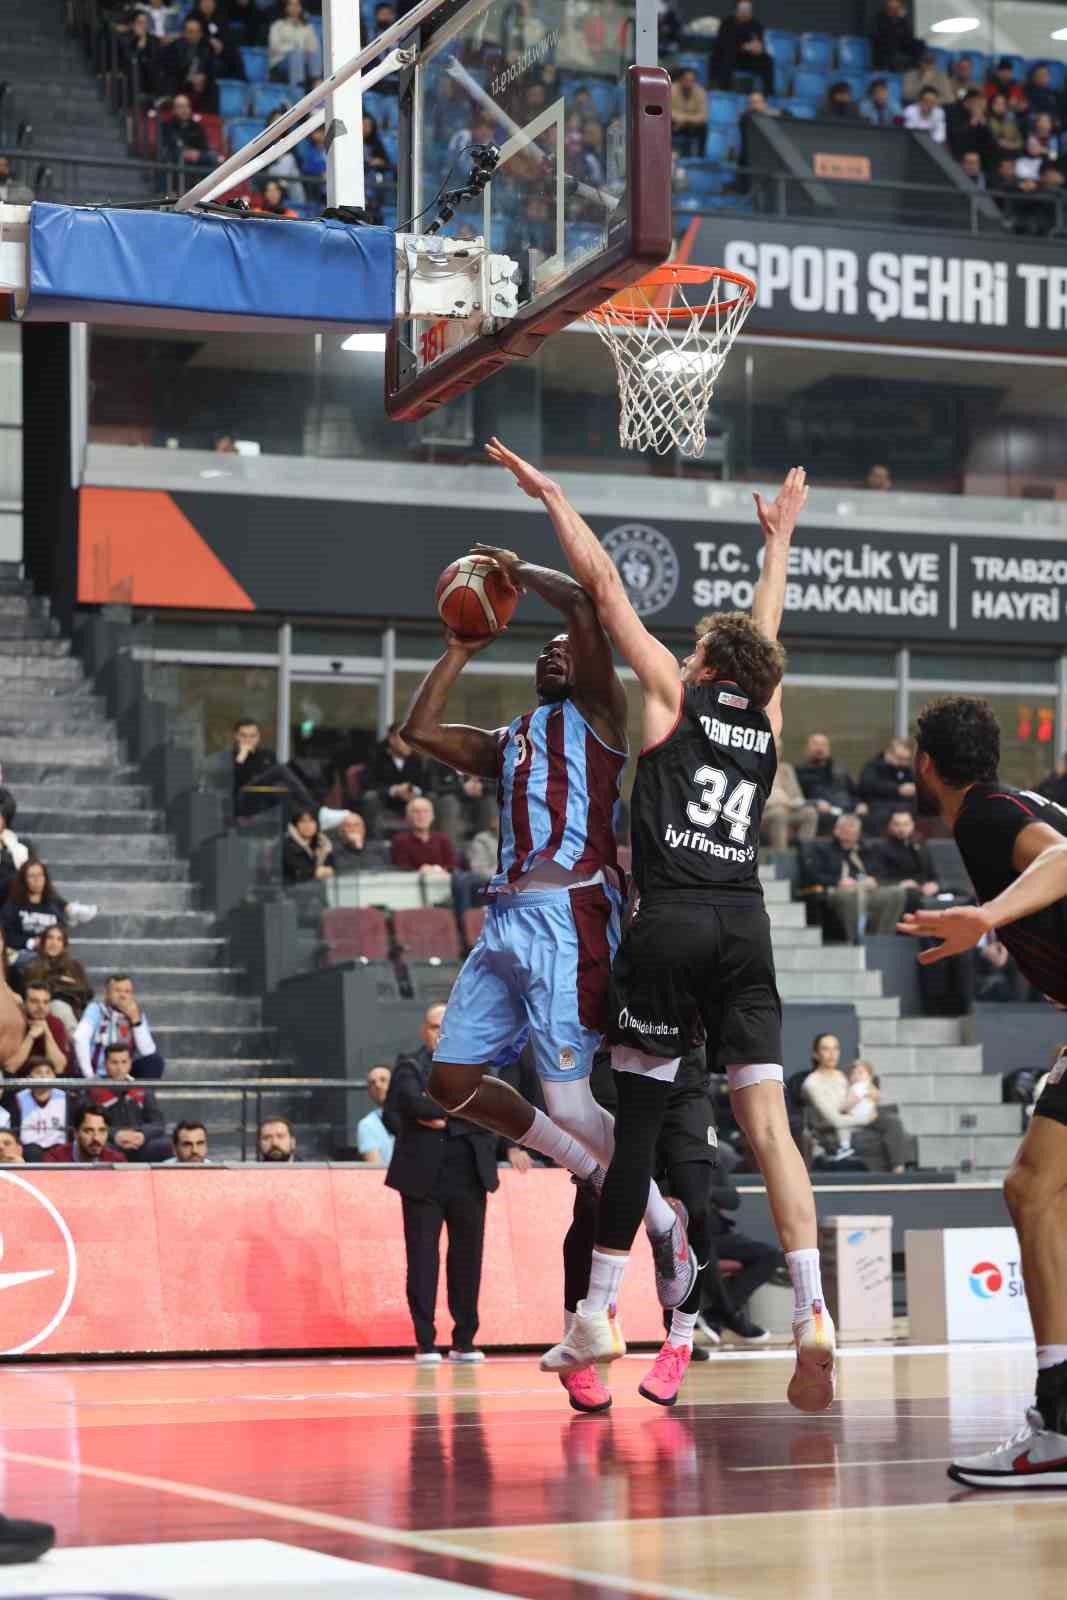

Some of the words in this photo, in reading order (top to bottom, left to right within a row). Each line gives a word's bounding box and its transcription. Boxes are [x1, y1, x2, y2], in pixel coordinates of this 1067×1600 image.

[724, 240, 859, 315] SPOR
[693, 541, 750, 574] T.C.
[898, 551, 940, 583] VE
[692, 578, 755, 610] SPO
[783, 581, 939, 618] BAKANLIĞI
[971, 586, 1060, 623] HAYRİ
[698, 714, 772, 755] OHNSON
[686, 764, 758, 845] 34
